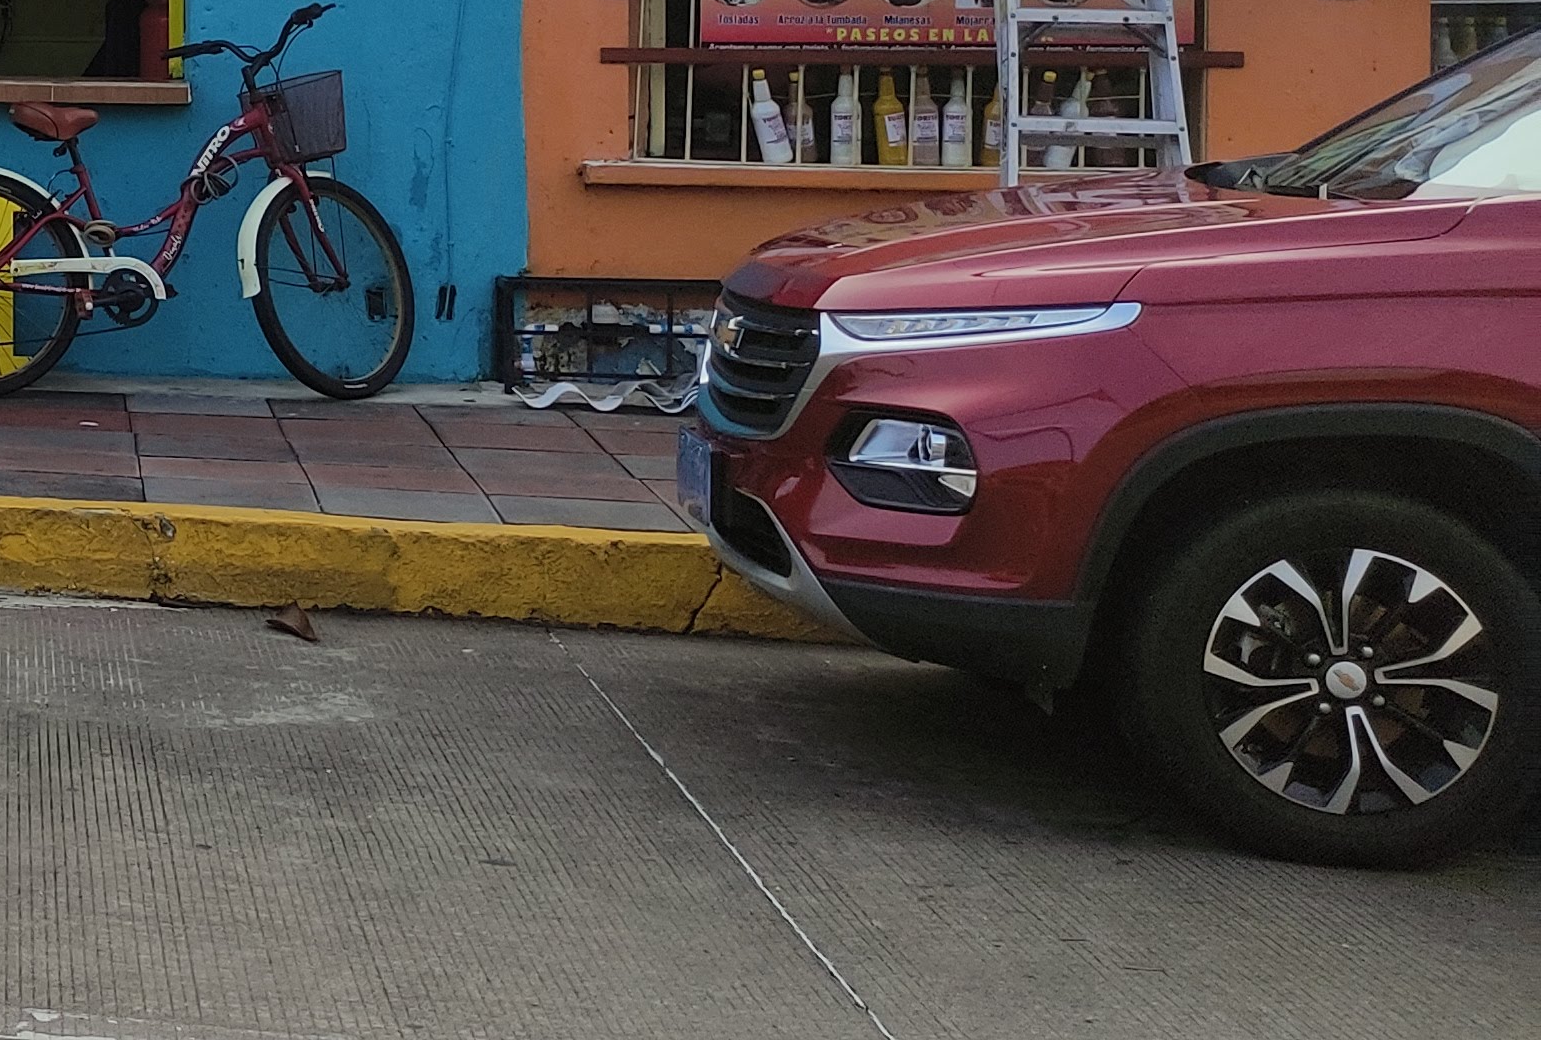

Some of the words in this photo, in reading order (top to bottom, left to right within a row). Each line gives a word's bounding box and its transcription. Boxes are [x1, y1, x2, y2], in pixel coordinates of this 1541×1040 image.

[718, 14, 759, 24] Tostadas
[778, 15, 805, 24] Arroz
[825, 15, 867, 24] Tumbada
[883, 15, 931, 25] Milanesas
[836, 27, 919, 42] PASEOS
[929, 28, 955, 42] EN
[963, 28, 989, 42] LA
[190, 125, 231, 176] NITRO
